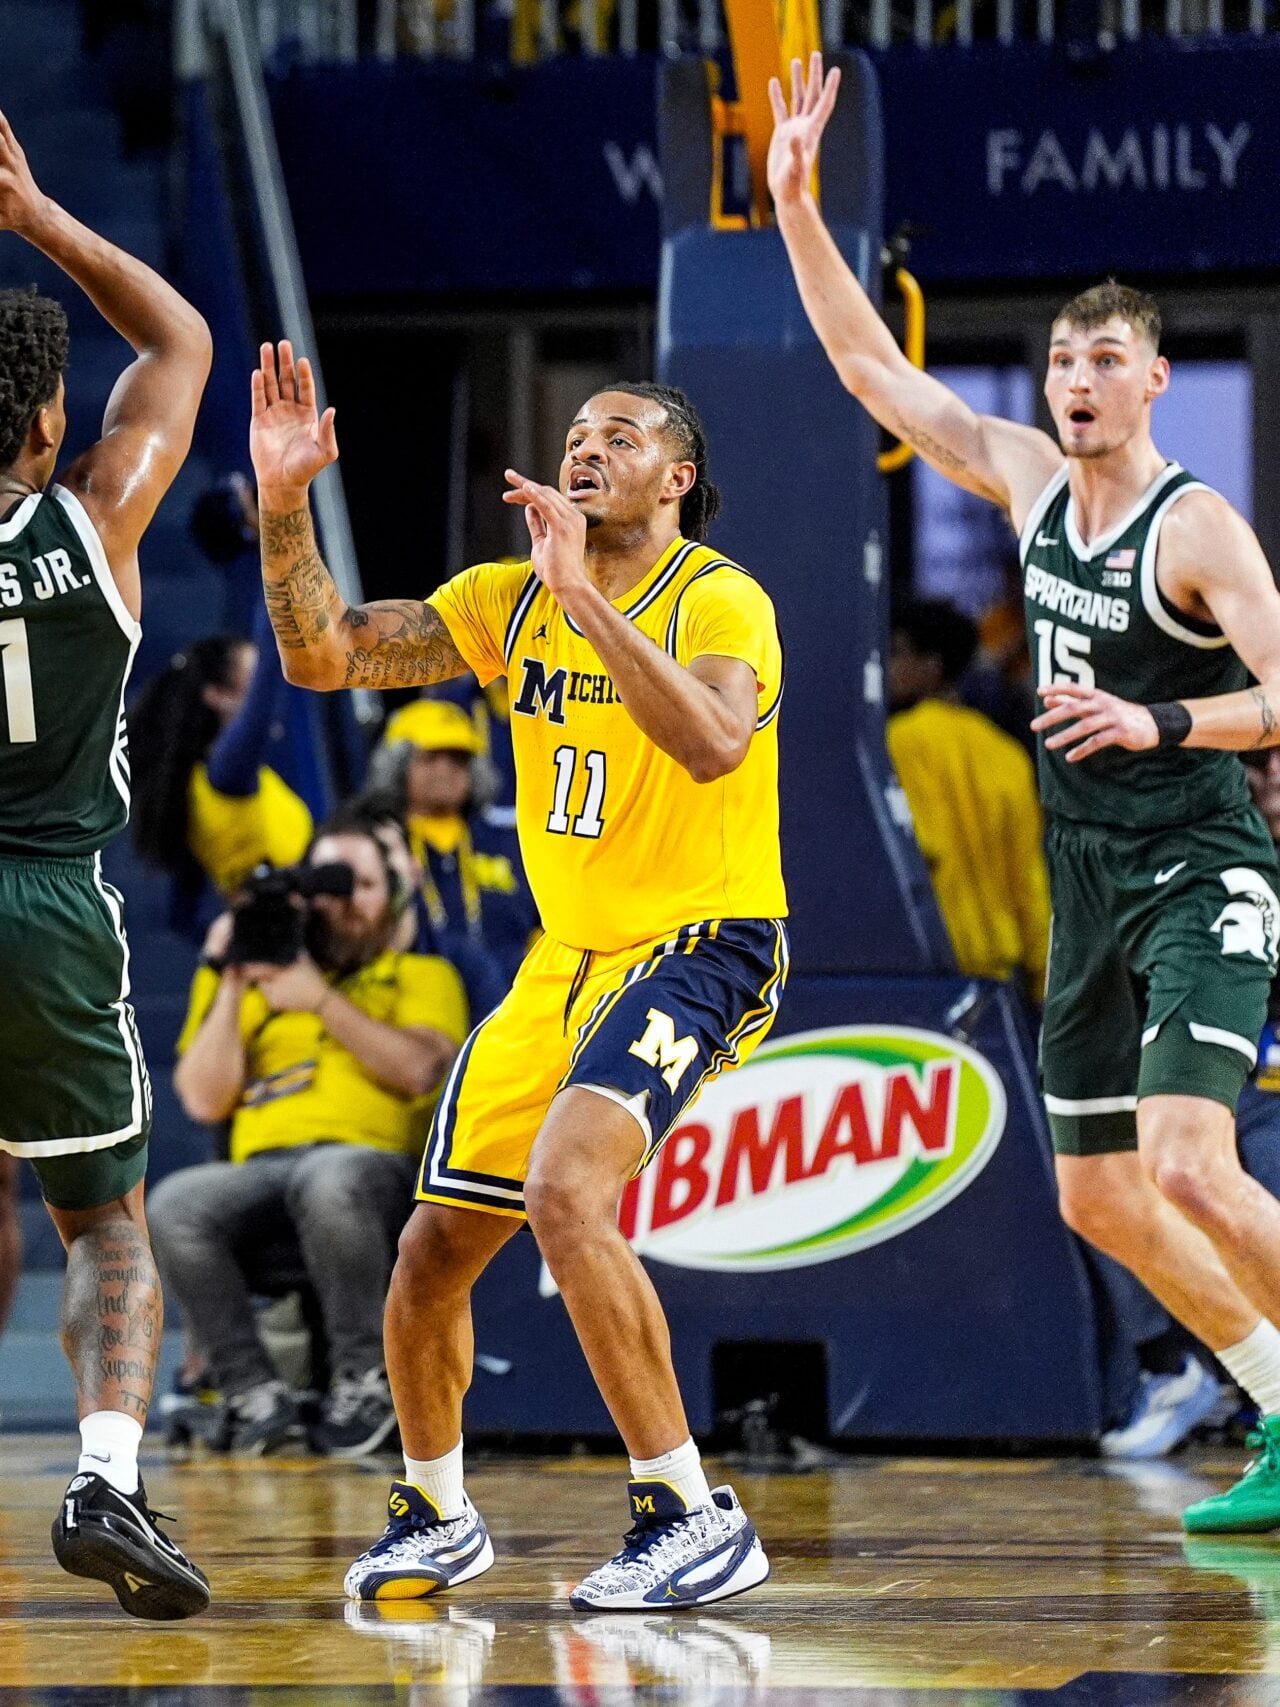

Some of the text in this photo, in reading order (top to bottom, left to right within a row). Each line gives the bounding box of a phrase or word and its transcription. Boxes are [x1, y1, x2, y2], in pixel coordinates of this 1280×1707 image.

[984, 121, 1252, 195] FAMILY
[31, 547, 92, 601] JR.
[1023, 562, 1131, 634] SPARTANS
[513, 656, 624, 727] MICHI
[1033, 618, 1096, 693] 15
[546, 744, 607, 840] 11
[628, 1007, 699, 1096] M
[618, 1065, 953, 1242] IBMAN
[631, 1494, 656, 1513] M
